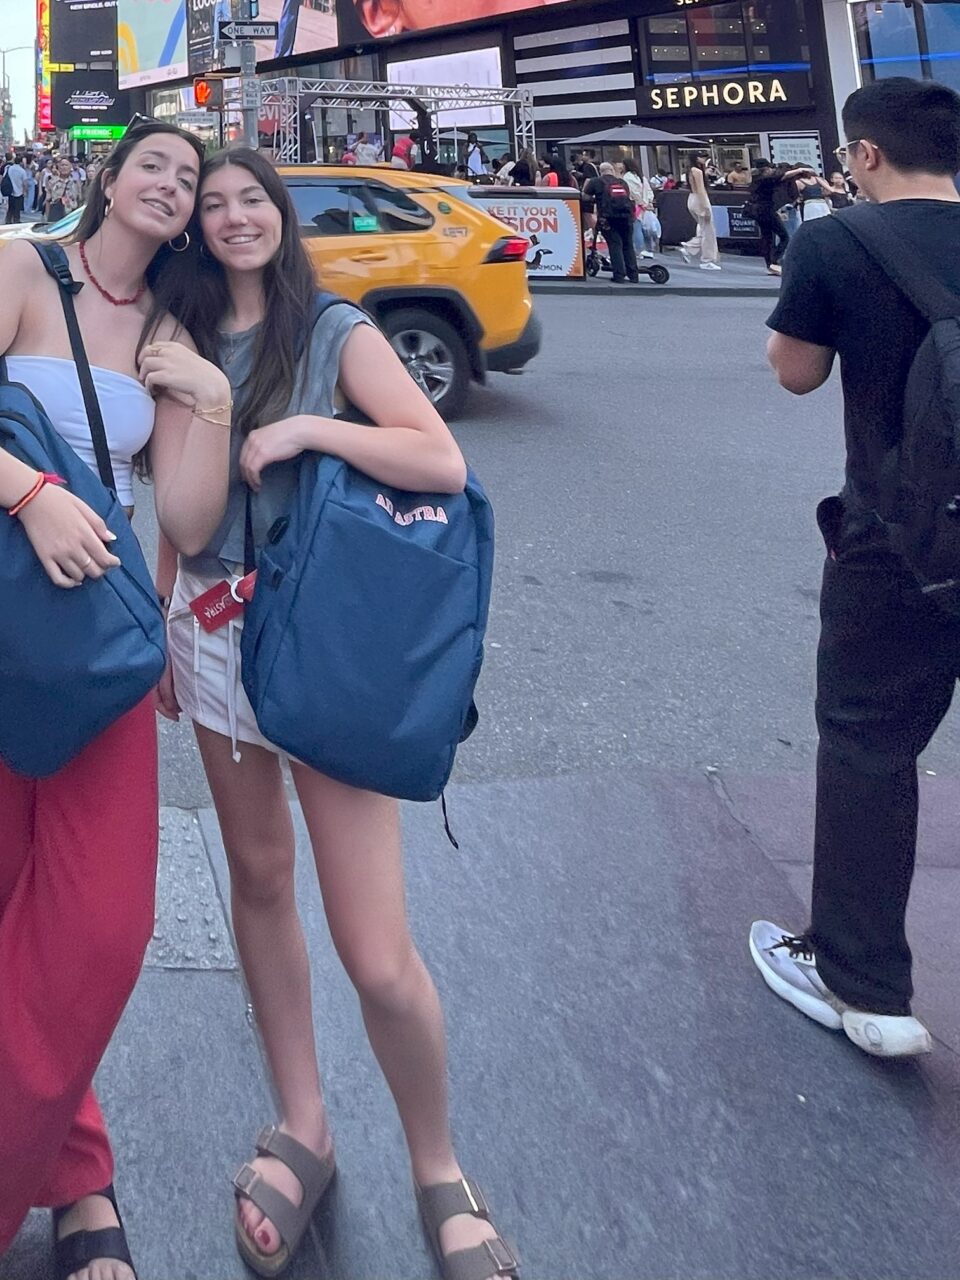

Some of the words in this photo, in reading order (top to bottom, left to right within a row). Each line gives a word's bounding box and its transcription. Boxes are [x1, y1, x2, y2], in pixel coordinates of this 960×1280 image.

[227, 26, 245, 35] ONE
[253, 27, 271, 35] WAY
[650, 78, 788, 110] SEPHORA
[488, 206, 505, 216] KE
[507, 206, 519, 216] IT
[521, 206, 558, 217] YOUR
[510, 217, 559, 234] SION
[394, 505, 449, 526] ASTRA
